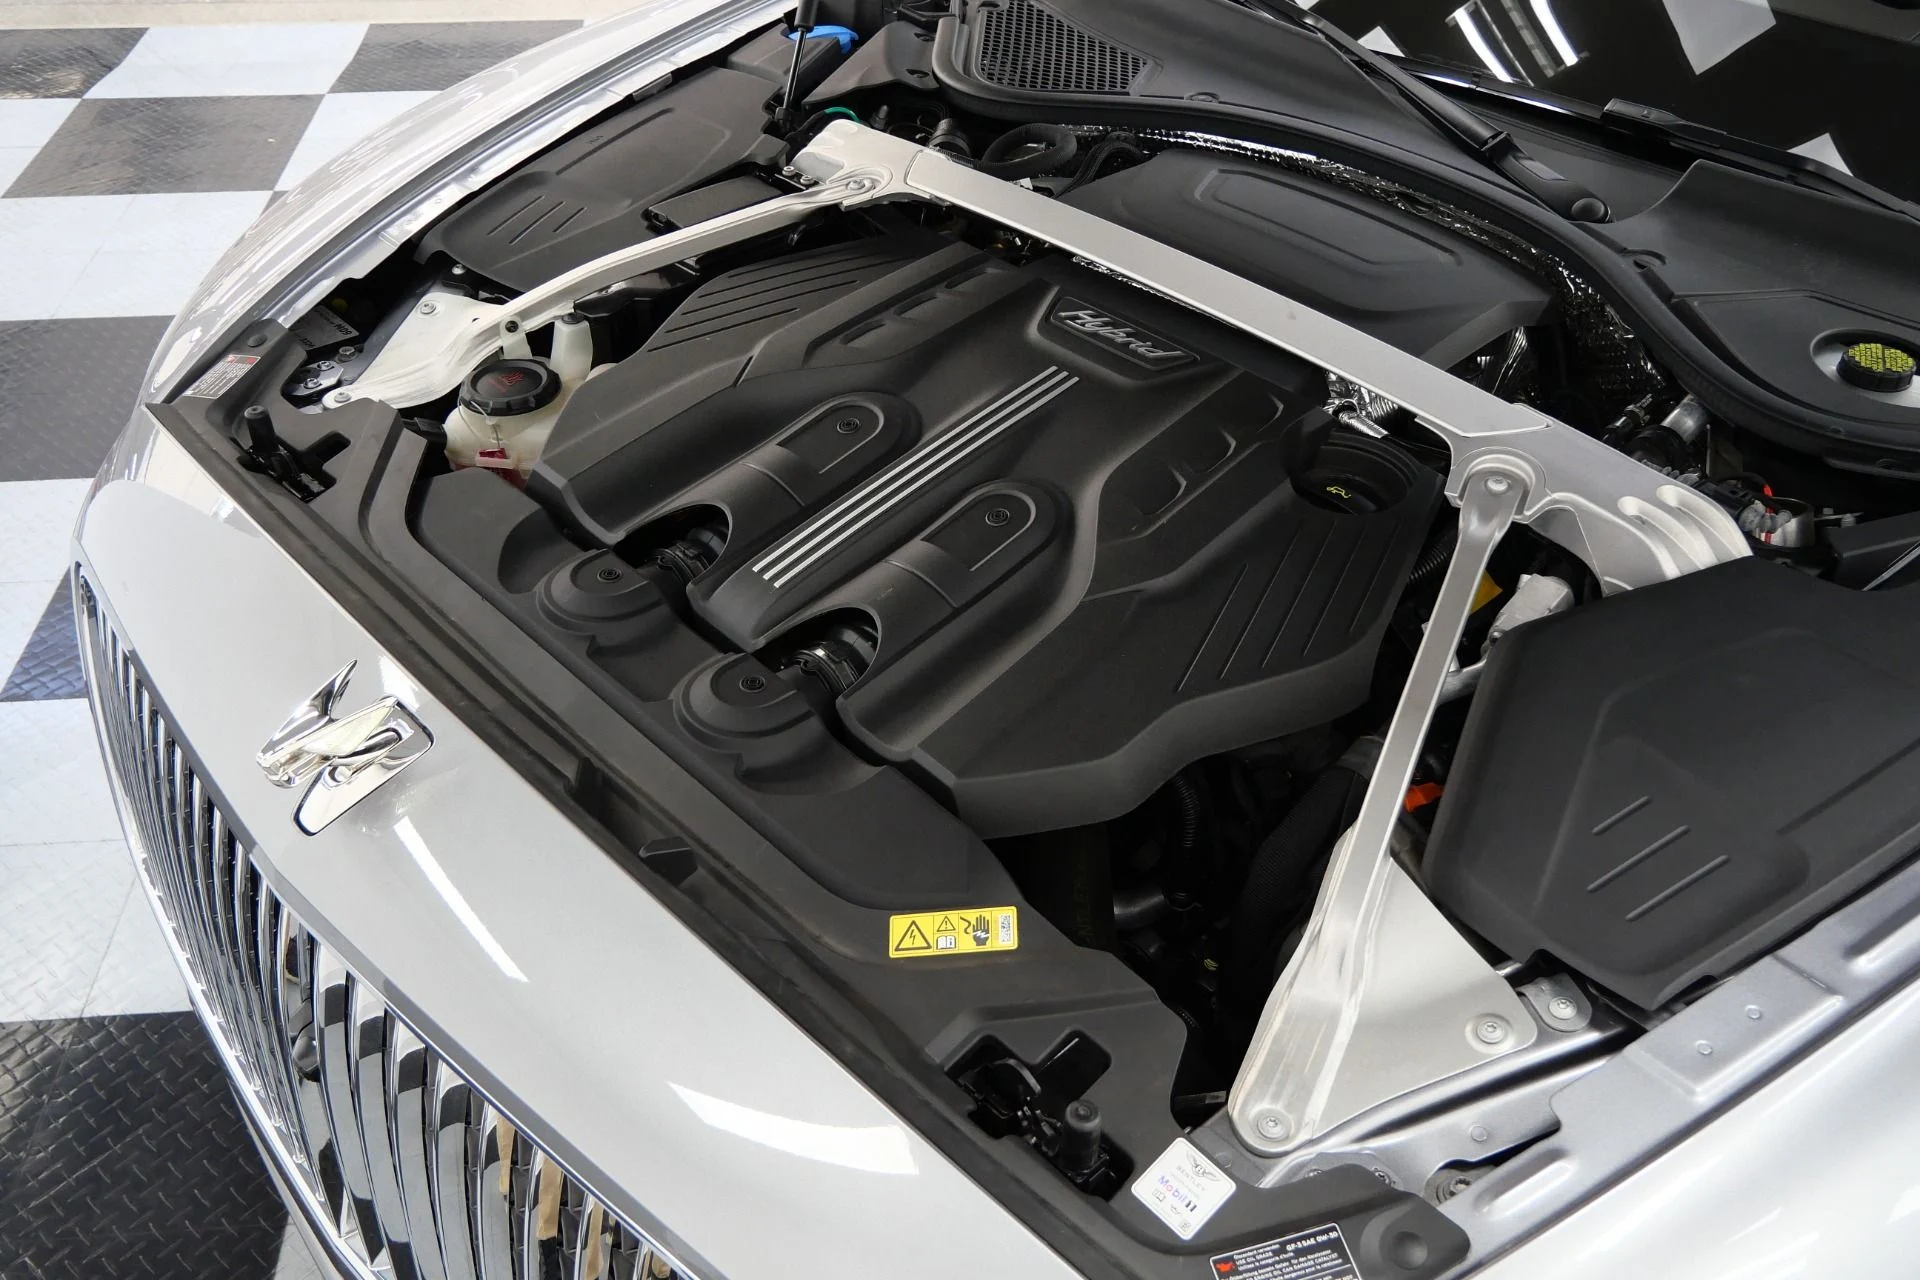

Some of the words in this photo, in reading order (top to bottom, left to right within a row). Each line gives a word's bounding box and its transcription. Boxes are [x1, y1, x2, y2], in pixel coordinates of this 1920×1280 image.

[1058, 310, 1188, 358] Hybrid
[1157, 1175, 1188, 1202] Mobil
[1302, 1237, 1316, 1248] SAE
